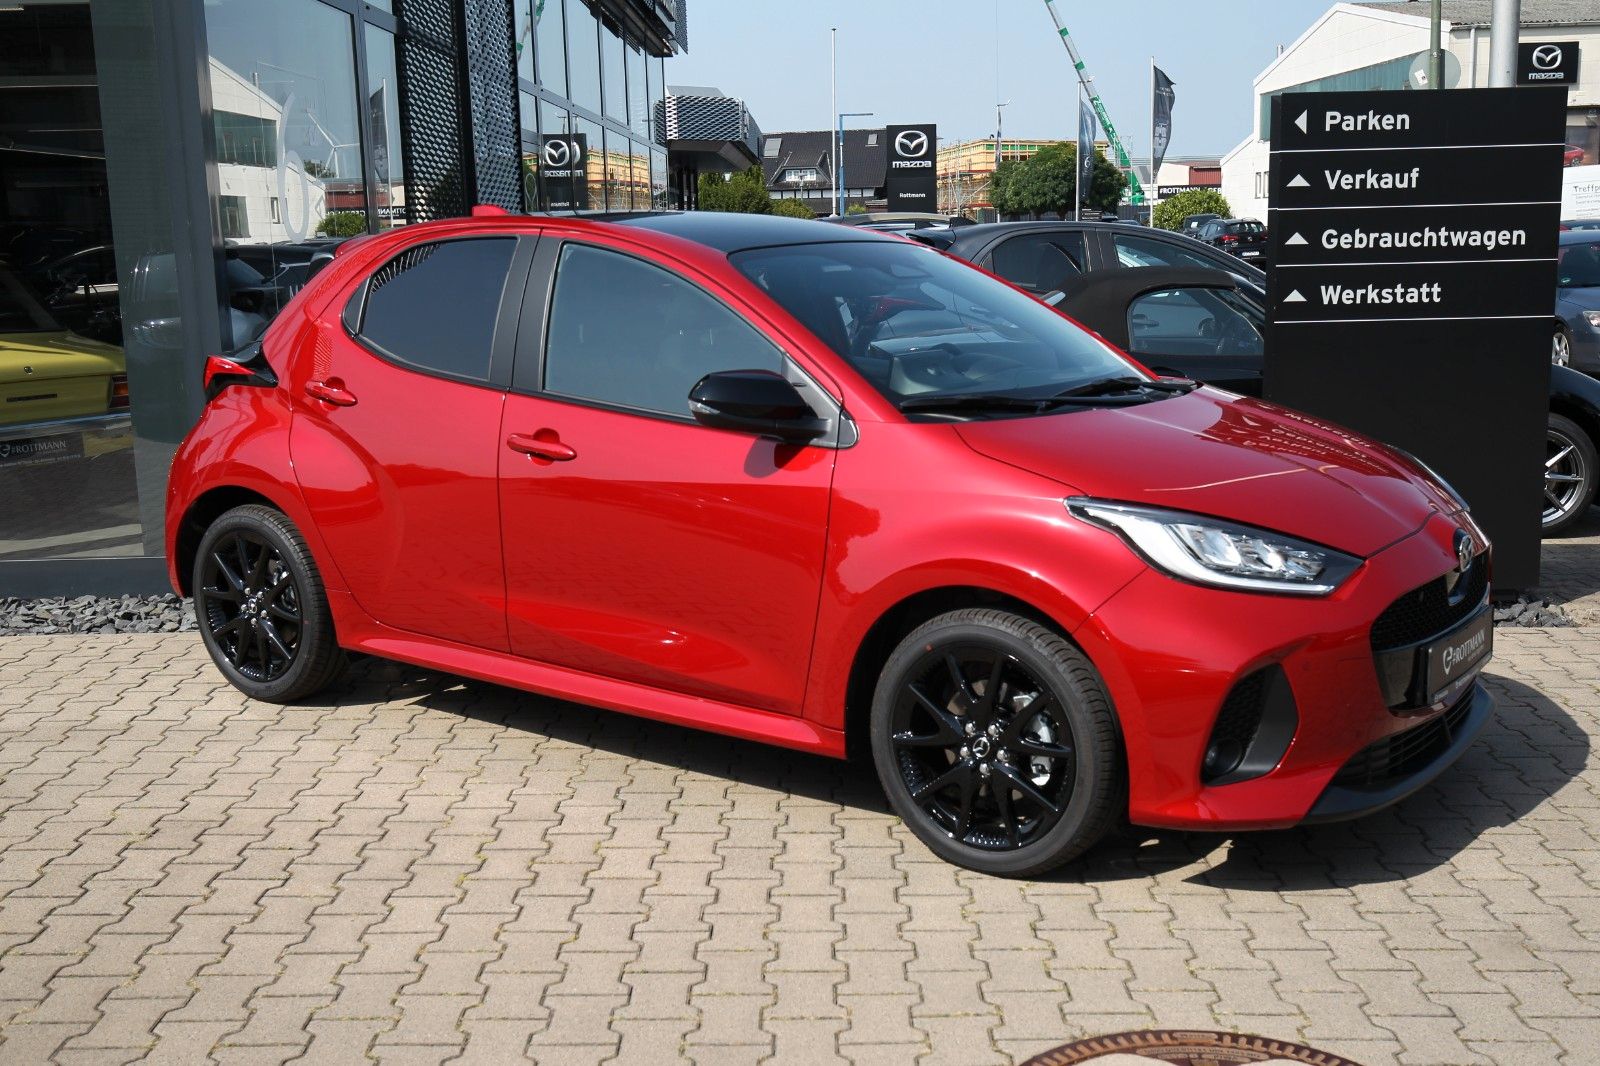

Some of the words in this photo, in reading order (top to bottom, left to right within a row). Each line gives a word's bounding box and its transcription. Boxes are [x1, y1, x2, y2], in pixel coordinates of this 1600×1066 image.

[1528, 72, 1564, 80] mazda
[1325, 109, 1410, 132] Parken
[892, 160, 932, 169] mazda
[1324, 167, 1420, 190] Verkauf
[1321, 226, 1527, 251] Gebrauchtwagen
[1320, 282, 1442, 305] Werkstatt
